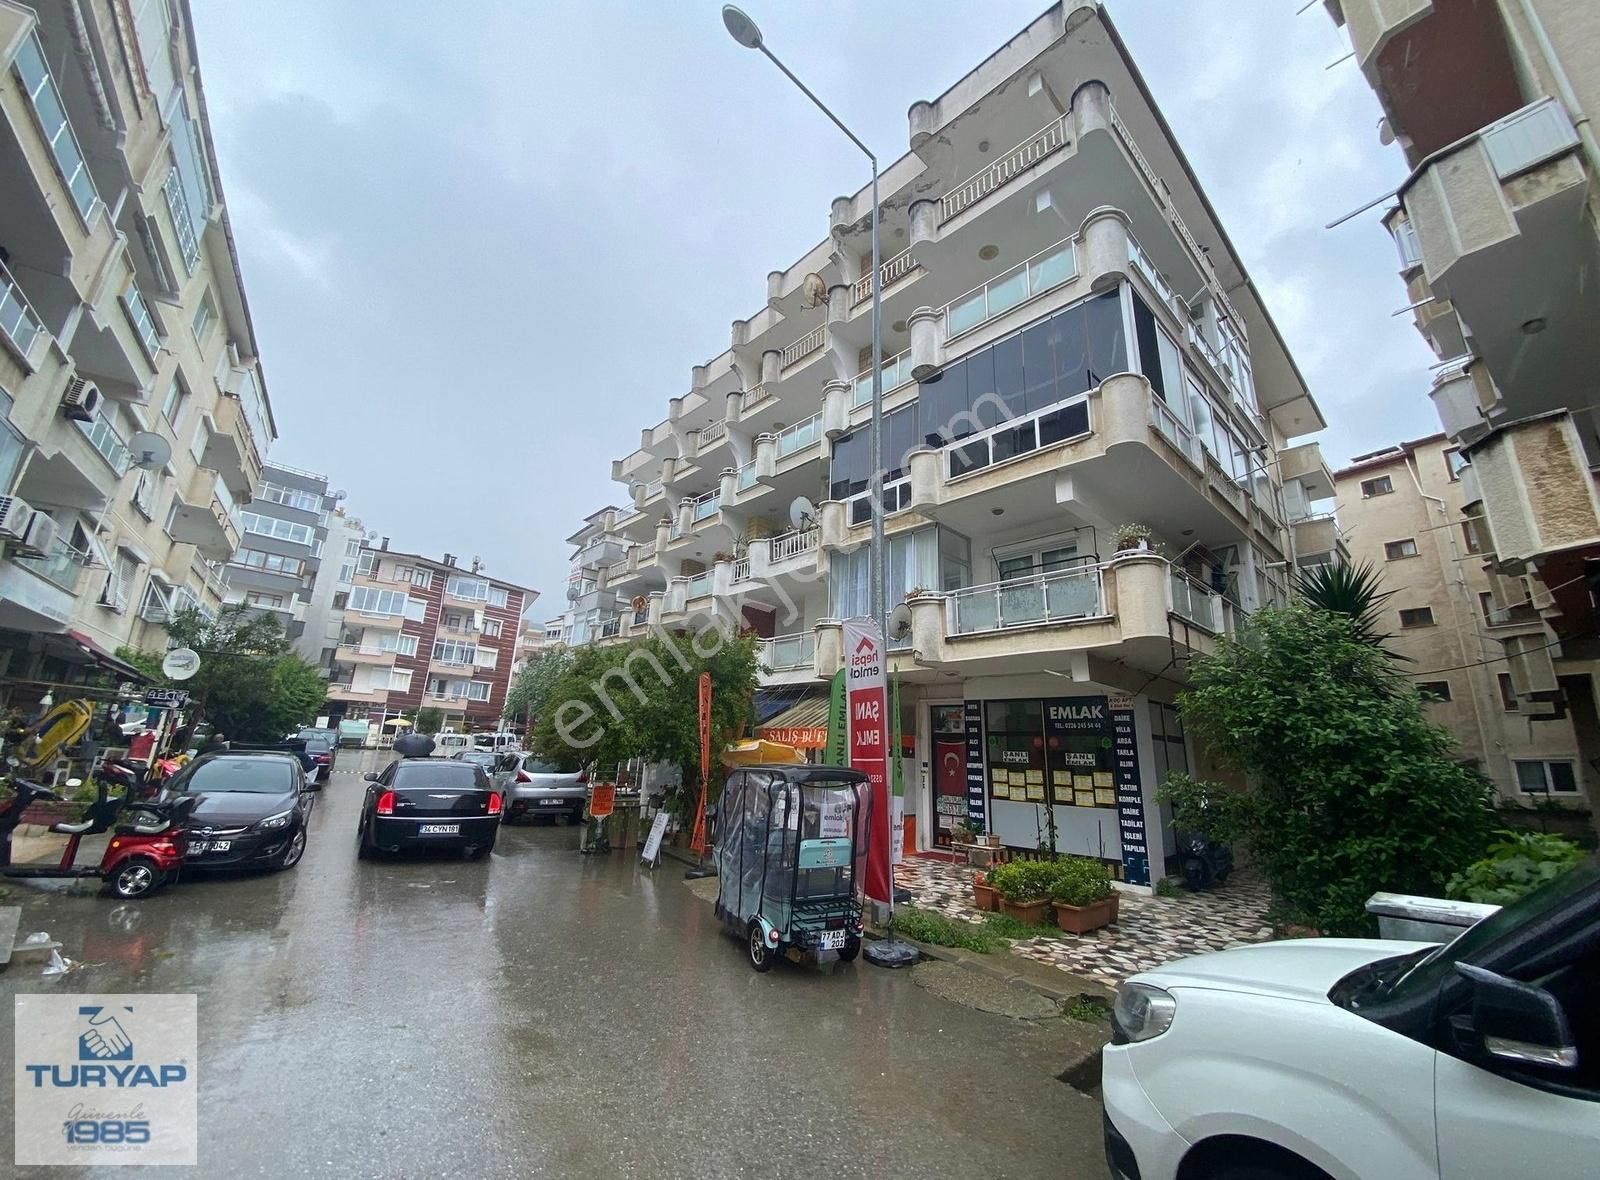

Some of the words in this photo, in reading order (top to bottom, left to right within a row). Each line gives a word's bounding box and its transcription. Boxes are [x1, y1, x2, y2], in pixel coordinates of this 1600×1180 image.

[1049, 705, 1104, 720] EMLAK
[1116, 737, 1132, 745] ARSA
[836, 734, 845, 766] ANLI
[1120, 784, 1138, 792] SATIM
[1118, 795, 1141, 804] KOMPLE
[1122, 807, 1140, 816] DAİRE
[1120, 819, 1143, 828] TADİLAT
[433, 825, 448, 833] CYN
[1123, 830, 1142, 841] İŞLERİ
[1123, 844, 1146, 853] YAPILIR
[822, 933, 830, 941] 77
[831, 931, 845, 939] ADJ
[831, 940, 844, 948] 202
